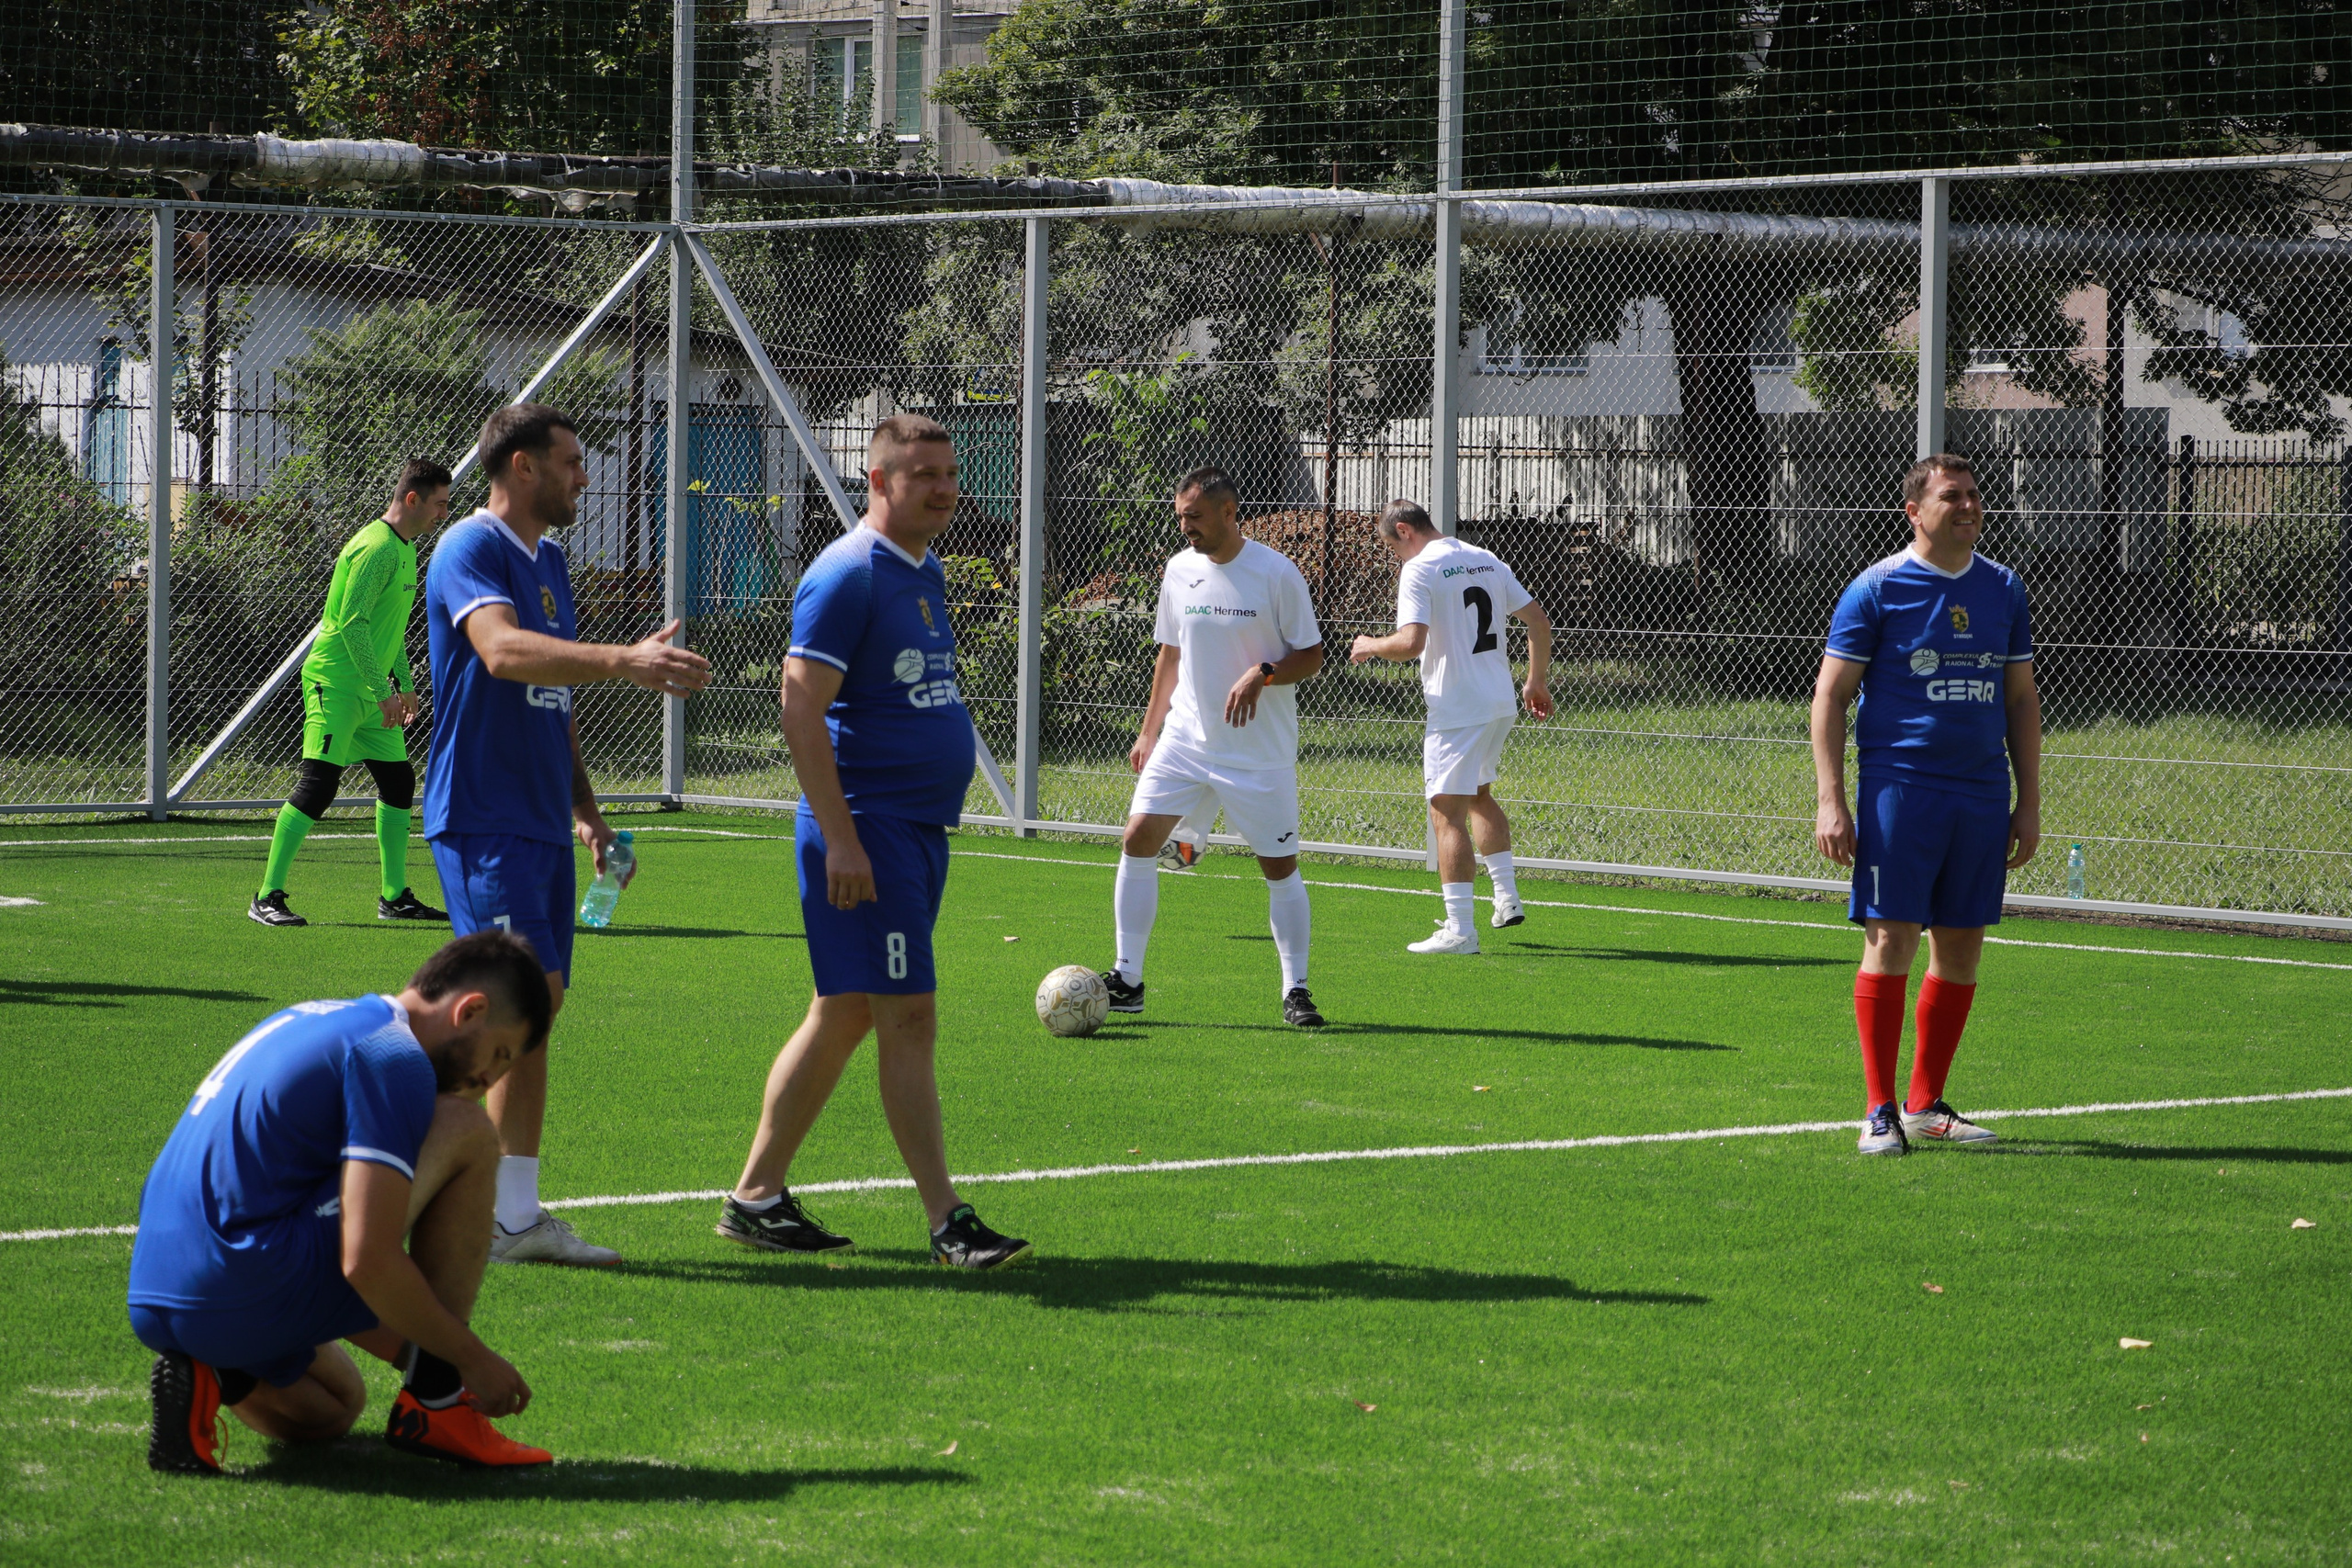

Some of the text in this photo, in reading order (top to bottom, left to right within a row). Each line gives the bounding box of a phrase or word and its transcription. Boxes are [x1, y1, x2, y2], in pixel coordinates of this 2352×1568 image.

[1442, 565, 1465, 579] DAAC
[1185, 605, 1257, 617] DAAC Hermes
[1463, 586, 1498, 654] 2
[908, 679, 962, 709] GER
[1926, 679, 1996, 704] GERA
[322, 734, 333, 755] 1
[1870, 865, 1880, 906] 1
[887, 931, 908, 979] 8
[190, 1015, 296, 1116] 4
